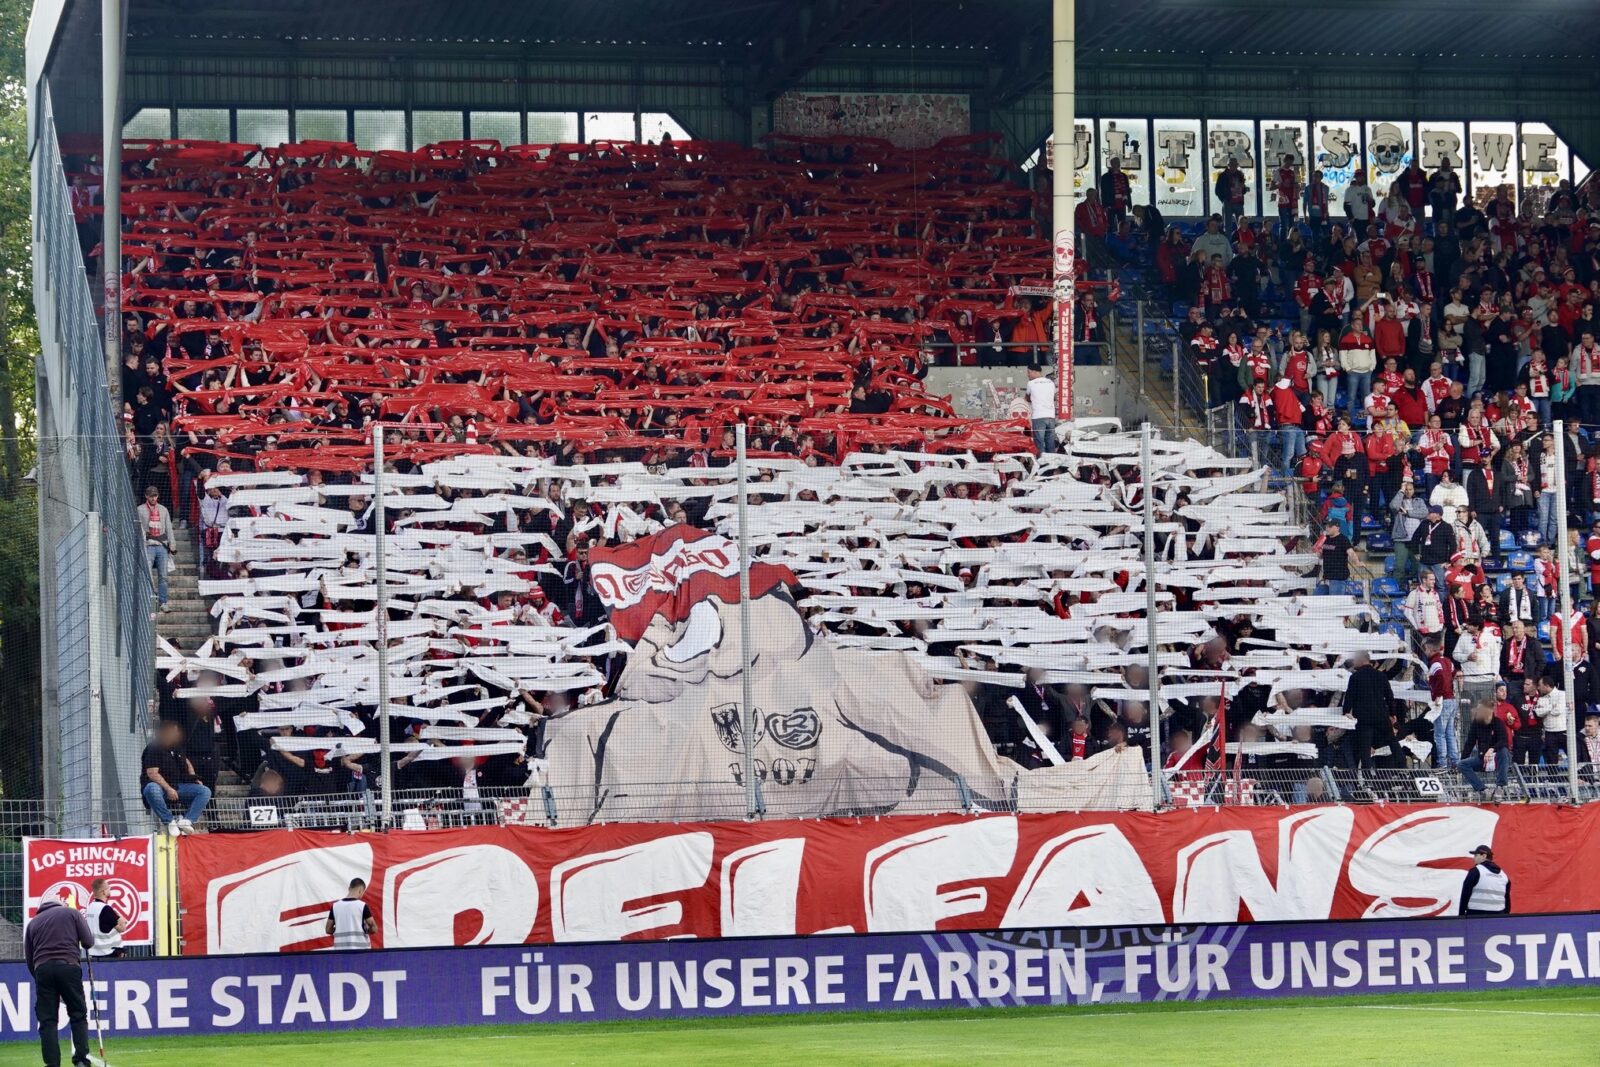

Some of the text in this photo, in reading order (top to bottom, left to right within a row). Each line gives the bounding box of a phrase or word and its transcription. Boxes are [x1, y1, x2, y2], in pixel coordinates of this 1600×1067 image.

[1422, 131, 1558, 171] RWE
[1419, 780, 1440, 791] 26
[253, 809, 274, 821] 27
[32, 846, 147, 872] LOS HINCHAS
[65, 862, 115, 878] ESSEN
[0, 978, 190, 1032] NERE
[210, 970, 407, 1027] STADT
[480, 952, 595, 1016] FÜR
[615, 956, 846, 1011] UNSERE
[866, 948, 1105, 1002] FARBEN,
[1125, 932, 1231, 994] FÜR
[1250, 936, 1467, 990] UNSERE
